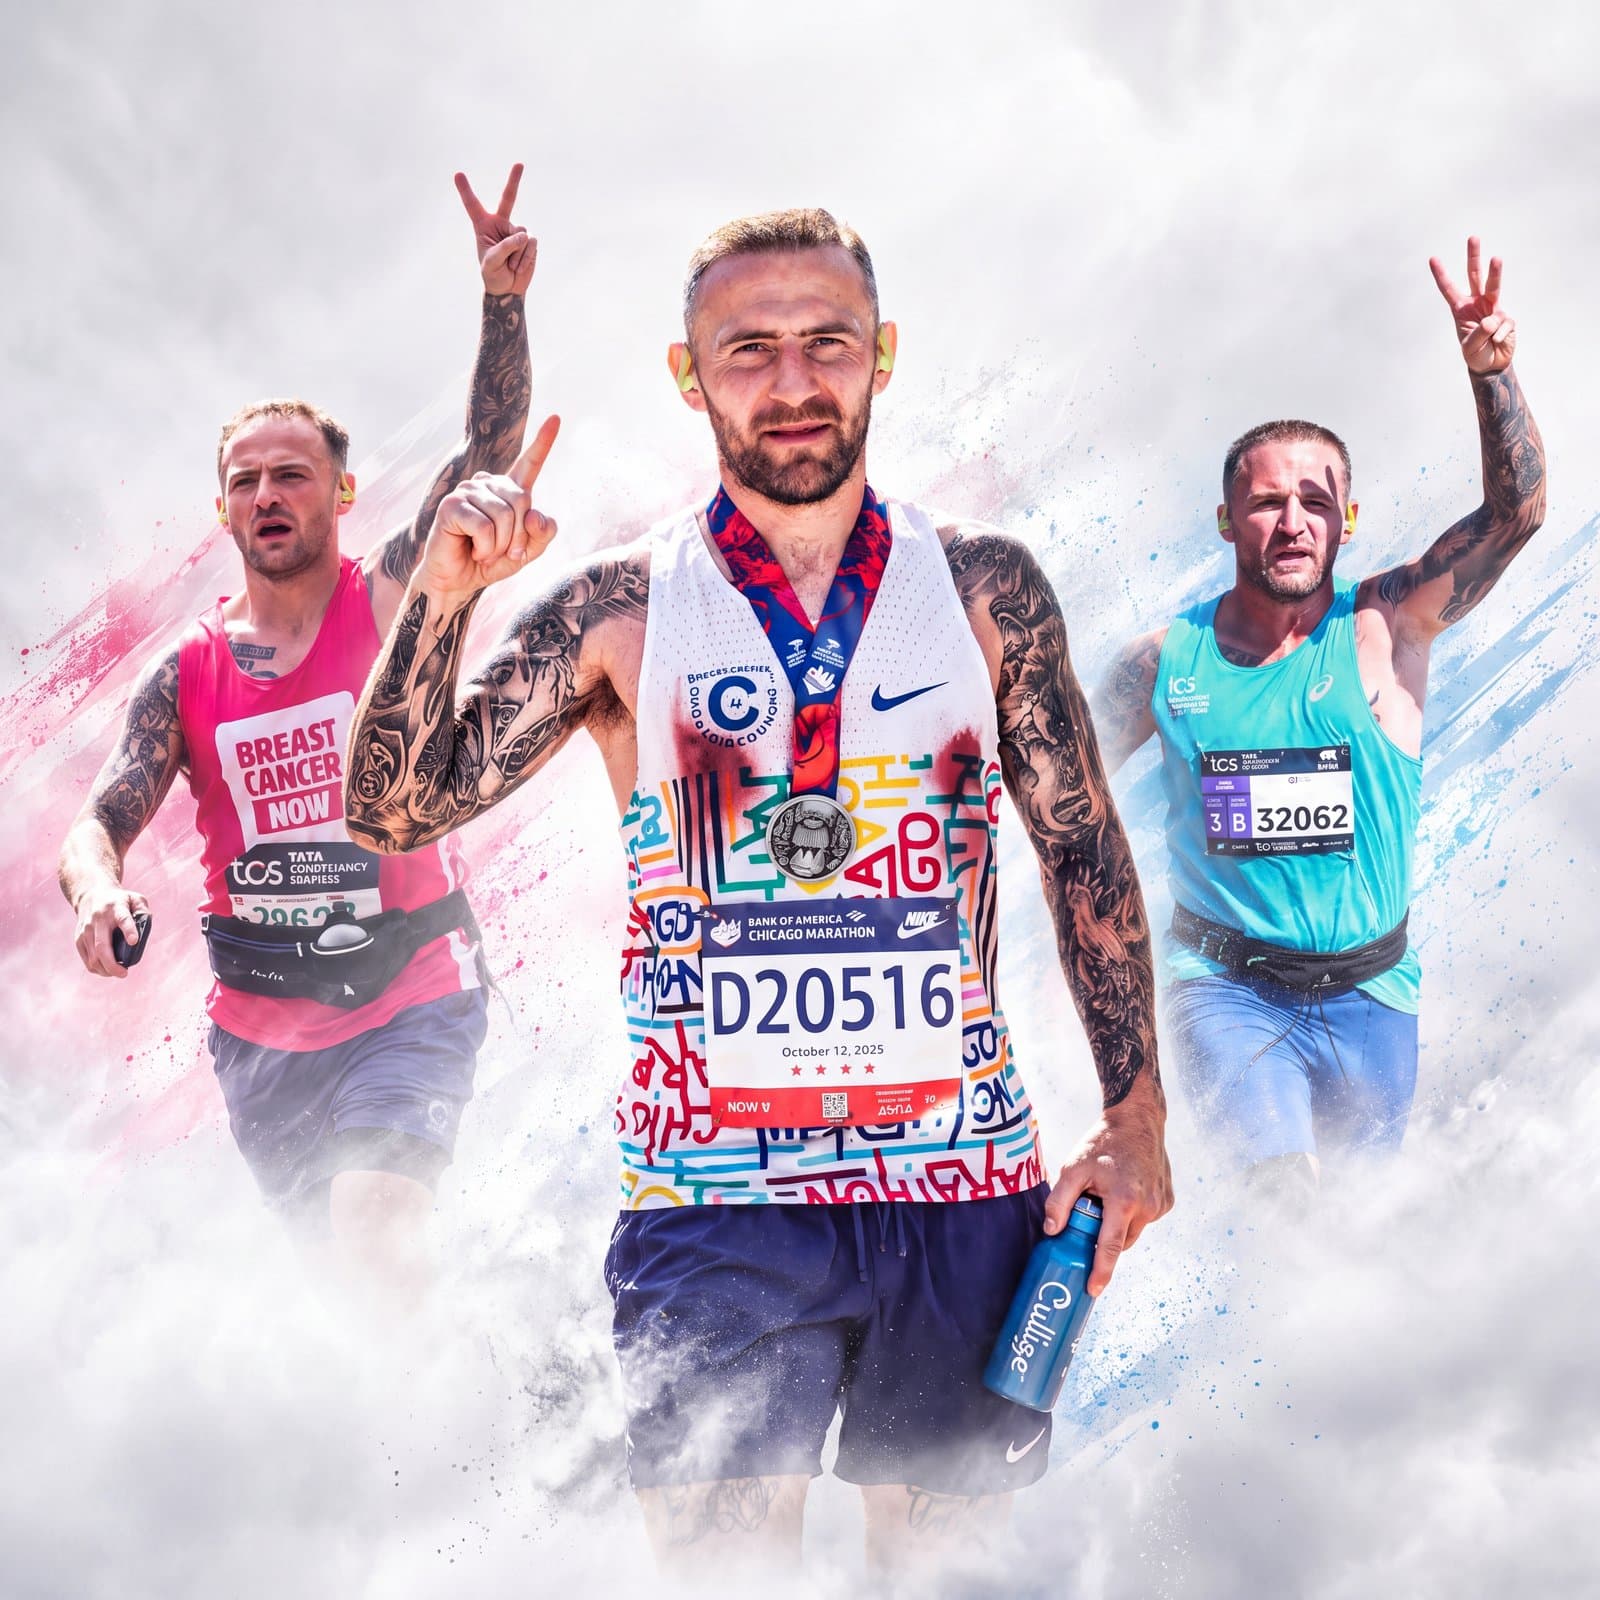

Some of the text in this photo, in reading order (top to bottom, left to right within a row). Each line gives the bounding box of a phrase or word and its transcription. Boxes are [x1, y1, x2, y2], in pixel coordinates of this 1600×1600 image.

[235, 718, 336, 769] BREAST
[1210, 755, 1239, 772] tcs
[244, 751, 343, 797] CANCER
[268, 790, 330, 830] NOW
[1210, 804, 1349, 832] 3 B 32062
[288, 851, 324, 862] TATA
[230, 855, 284, 886] tcs
[748, 914, 843, 927] BANK OF AMERICA
[904, 911, 940, 927] NIKE
[748, 926, 875, 941] CHICAGO MARATHON
[711, 963, 954, 1036] D20516
[782, 1044, 885, 1058] October 12, 2025
[728, 1101, 759, 1113] NOW
